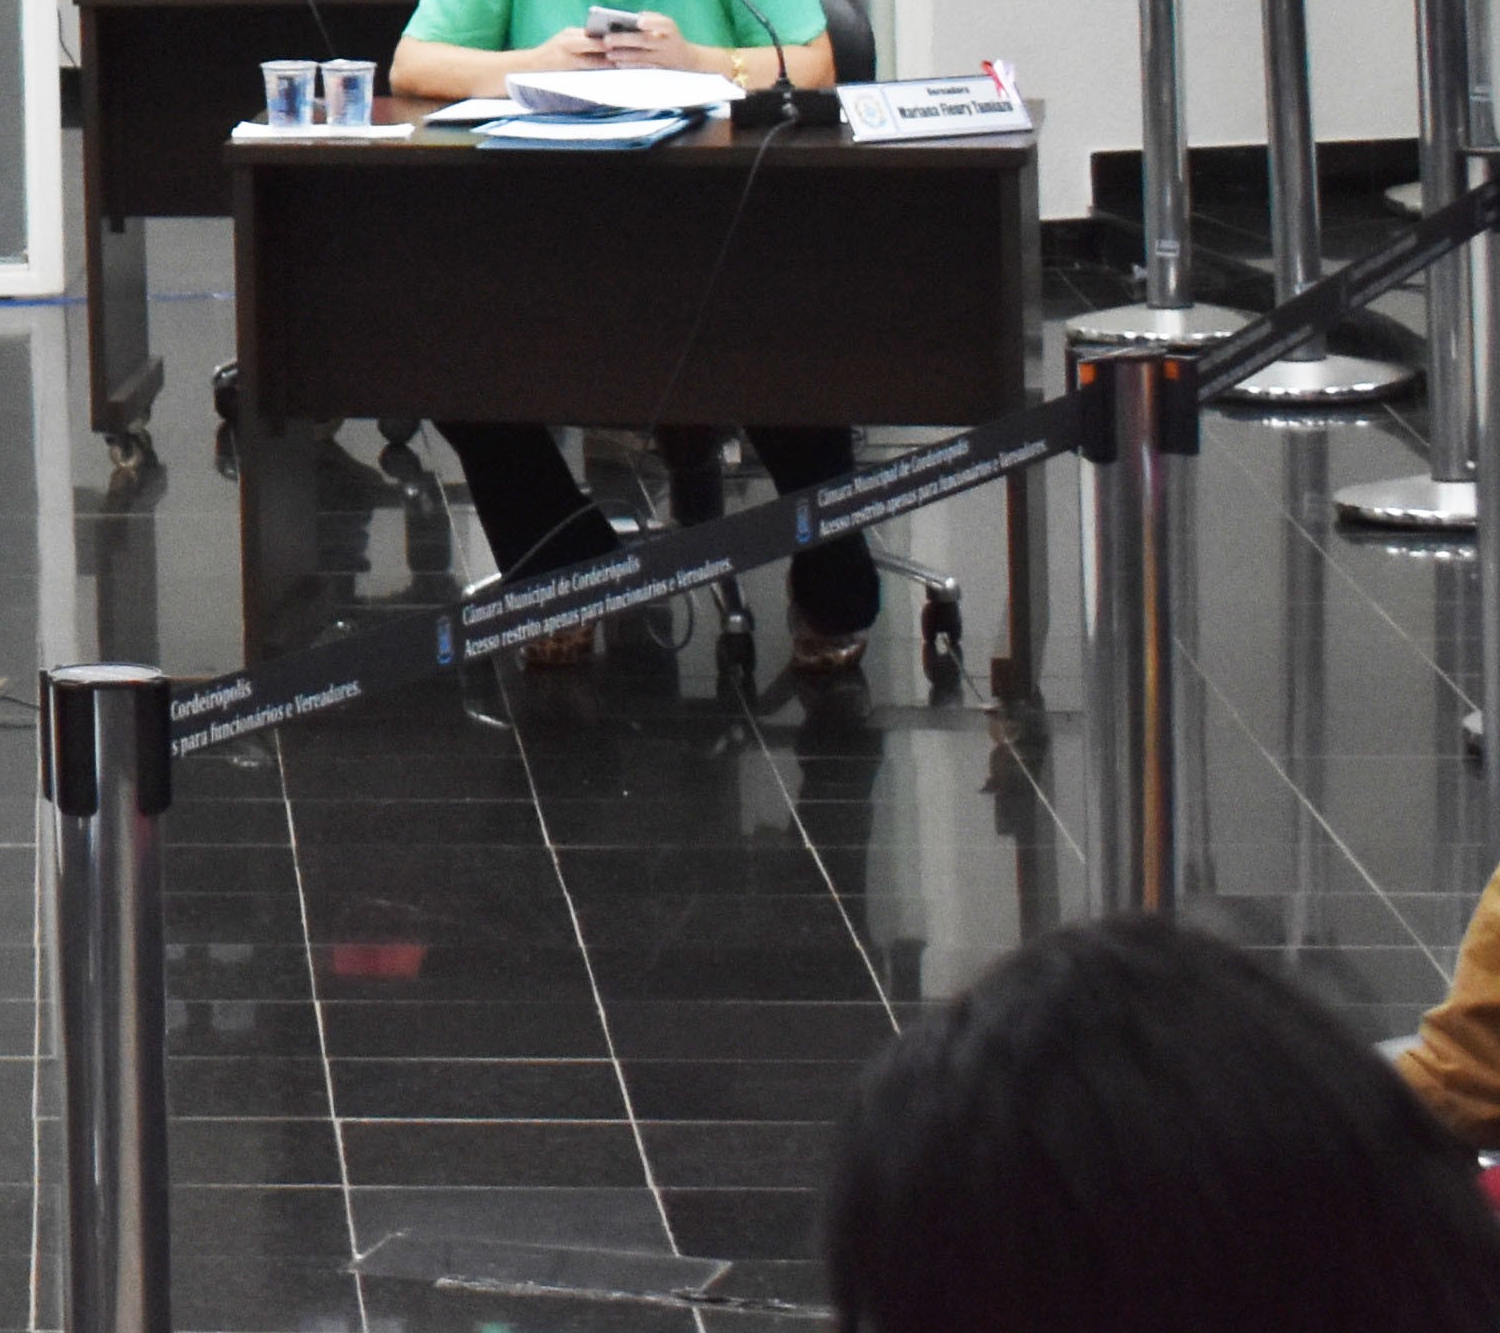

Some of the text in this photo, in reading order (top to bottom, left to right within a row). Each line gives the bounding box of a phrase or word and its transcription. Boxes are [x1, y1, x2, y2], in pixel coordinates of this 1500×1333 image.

[462, 599, 503, 625] Câmara
[504, 578, 556, 611] Municipal
[557, 576, 571, 596] de
[464, 632, 500, 657] Acesso
[501, 617, 542, 646] restrito
[543, 610, 579, 633] apenas
[580, 600, 604, 626] para
[668, 574, 676, 585] e
[170, 678, 252, 721] Cordeirópolis
[180, 730, 208, 758] para
[210, 701, 285, 744] funcionários
[285, 701, 293, 718] e
